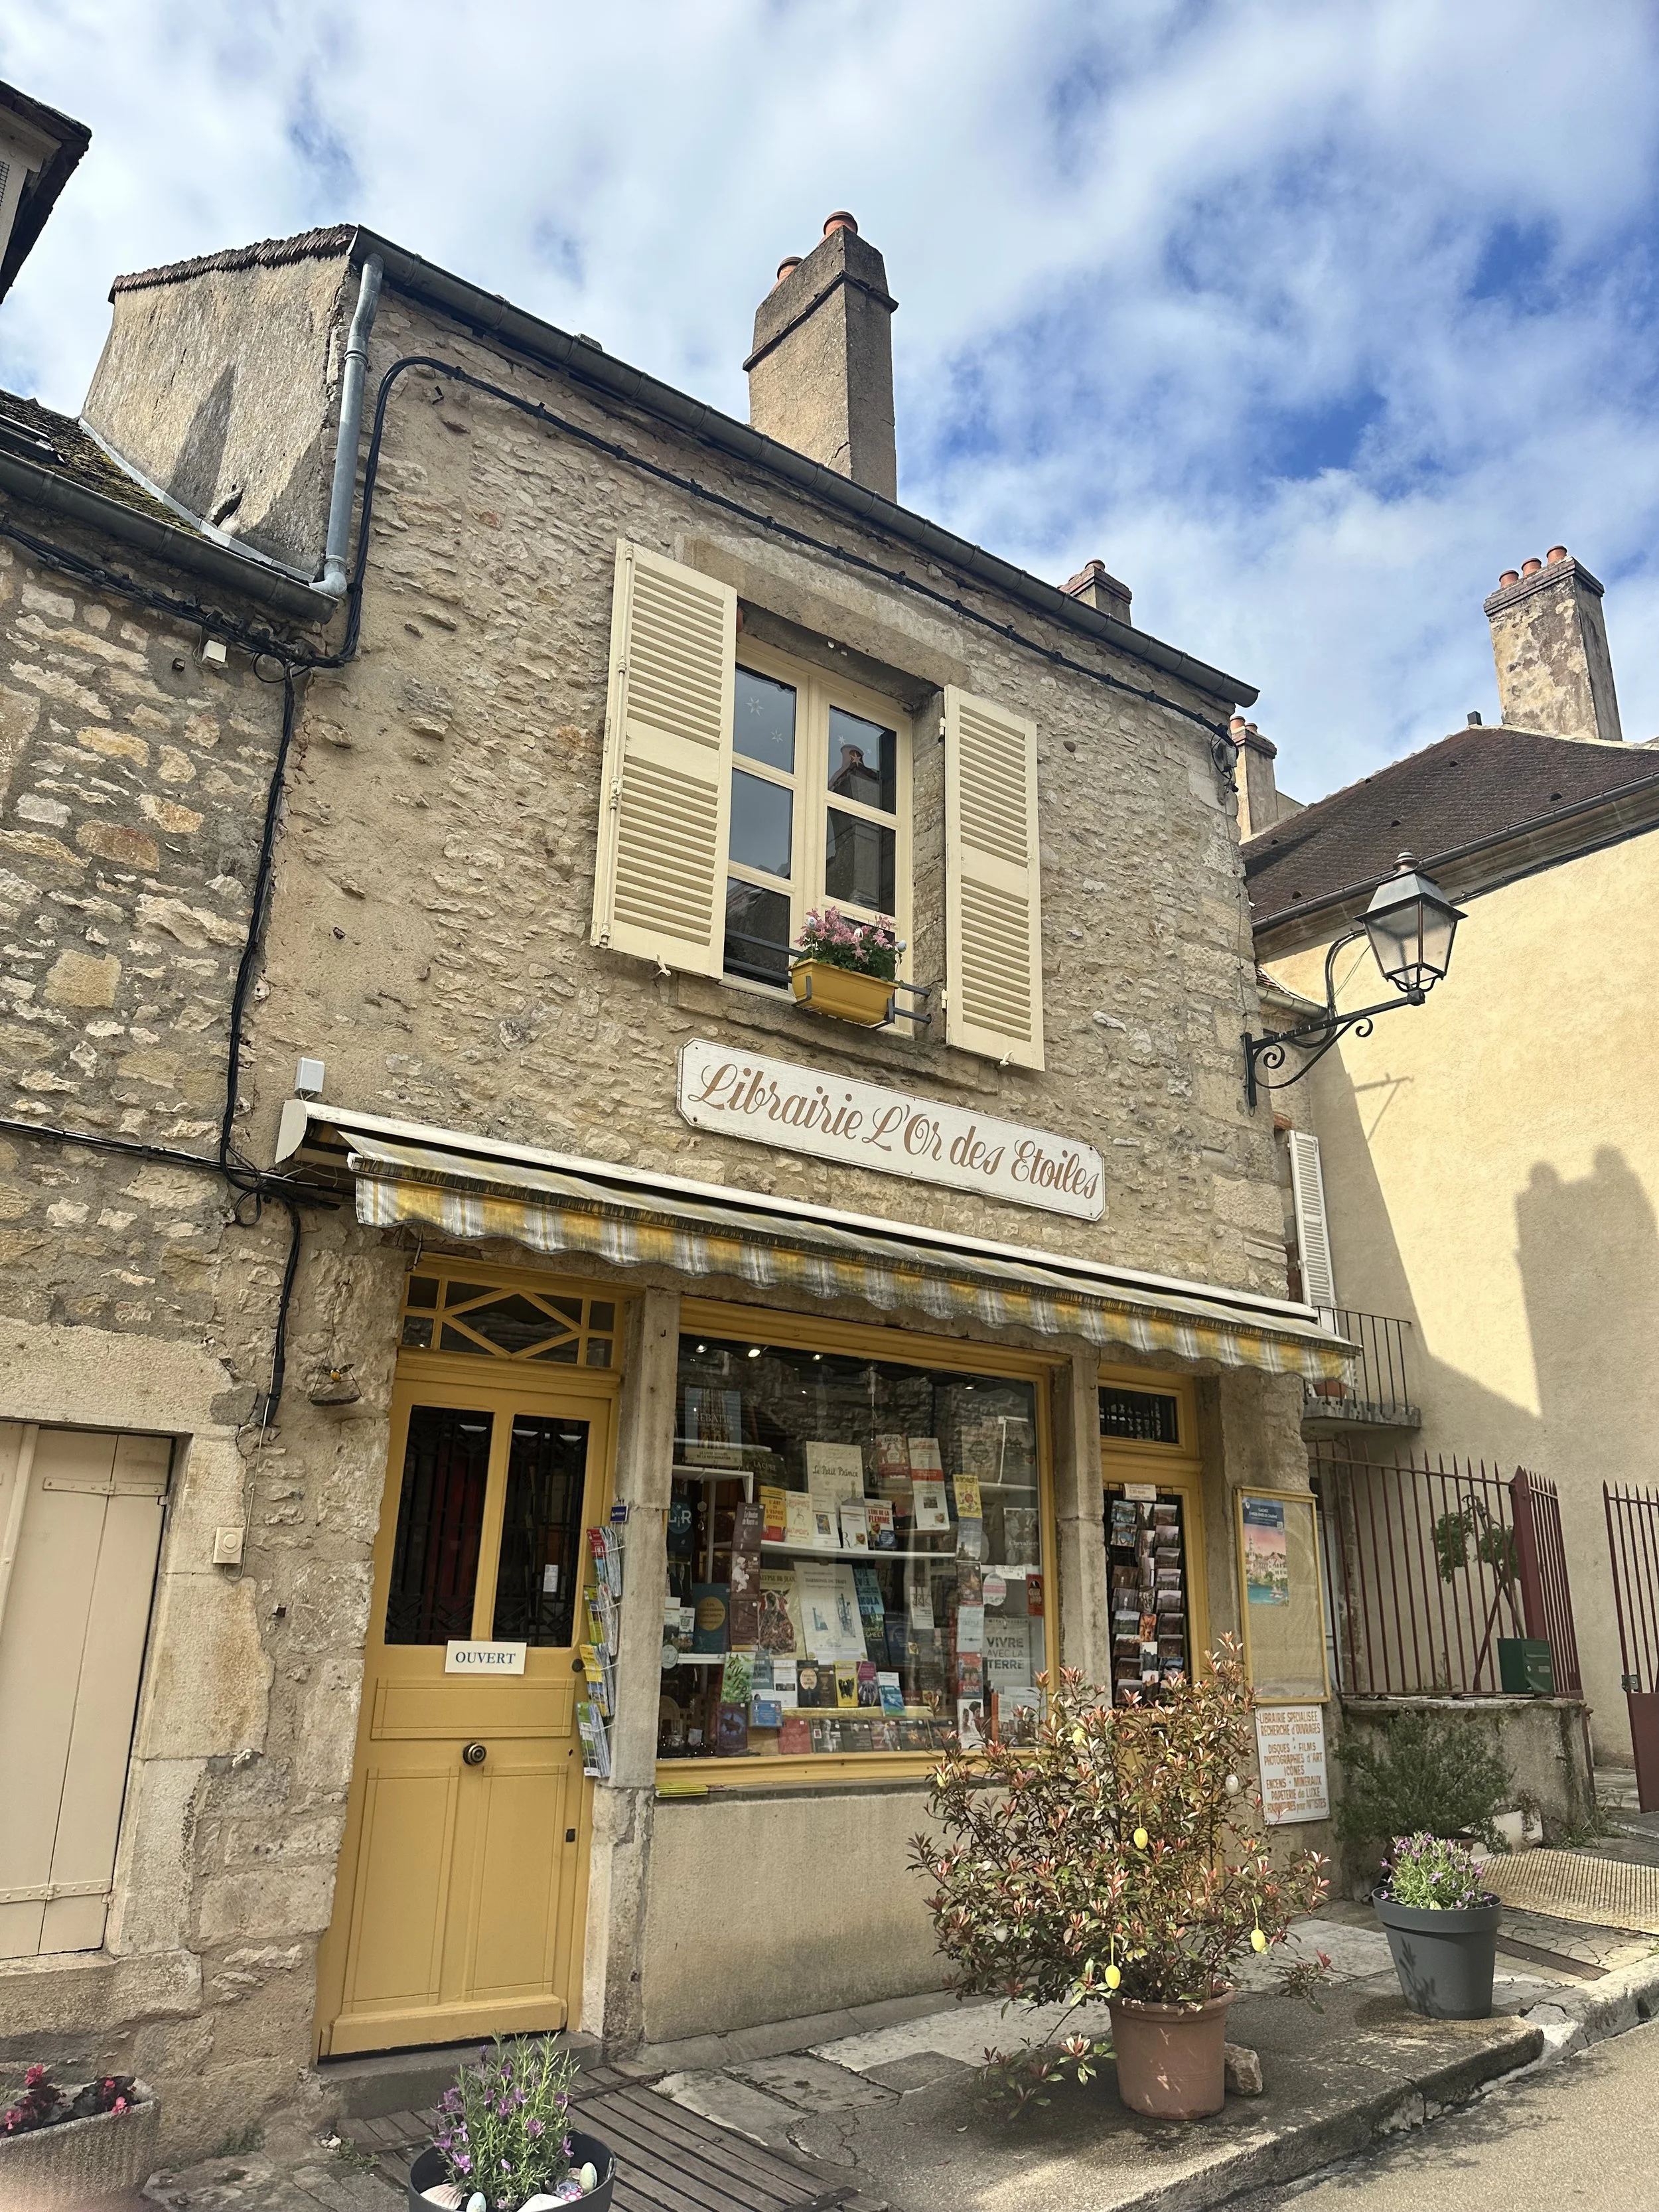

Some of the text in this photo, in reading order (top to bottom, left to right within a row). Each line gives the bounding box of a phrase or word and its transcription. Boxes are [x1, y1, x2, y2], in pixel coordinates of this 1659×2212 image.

[687, 1063, 1100, 1199] Librairie L'Or des Etoiles
[812, 1465, 859, 1477] Le Petit Prince
[869, 1515, 890, 1524] FLEMME
[987, 1637, 1024, 1648] VIVRE
[455, 1651, 516, 1664] OUVERT
[987, 1649, 1010, 1658] AVEC
[987, 1659, 1025, 1670] TERRE
[1260, 1712, 1285, 1724] LIBRAIRIE
[1261, 1723, 1321, 1736] RECHERCHE d'OUVRAGES
[1268, 1741, 1317, 1755] DISQUES FILMS
[1263, 1751, 1323, 1765] PHOTOGRAPHIES d'ART
[1266, 1778, 1286, 1790] ENCENS
[1271, 1787, 1321, 1801] PAPETERIE de LUXE
